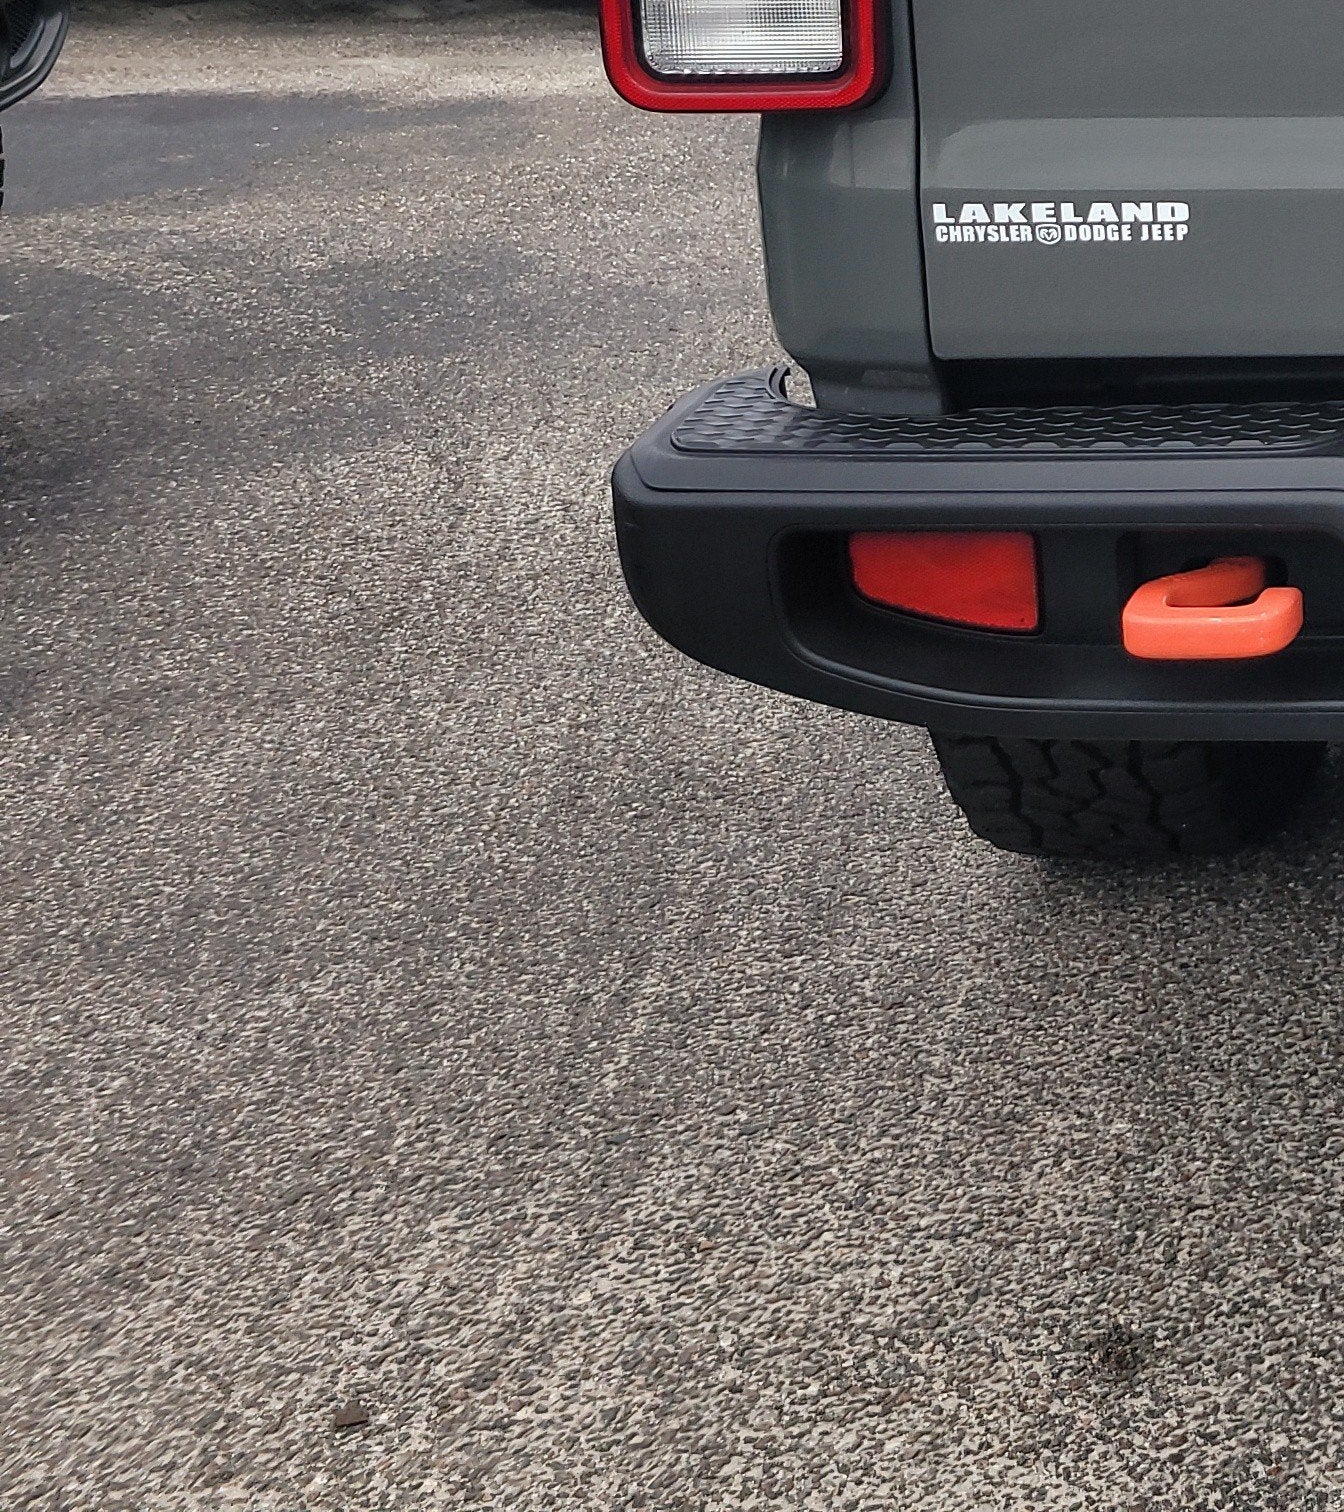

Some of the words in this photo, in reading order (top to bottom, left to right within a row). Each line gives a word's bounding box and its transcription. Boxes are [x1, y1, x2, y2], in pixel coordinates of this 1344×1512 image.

[932, 201, 1191, 224] LAKELAND
[935, 224, 1034, 242] CHRYSLER
[1064, 224, 1132, 242] DODGE
[1141, 224, 1190, 241] JEEP
